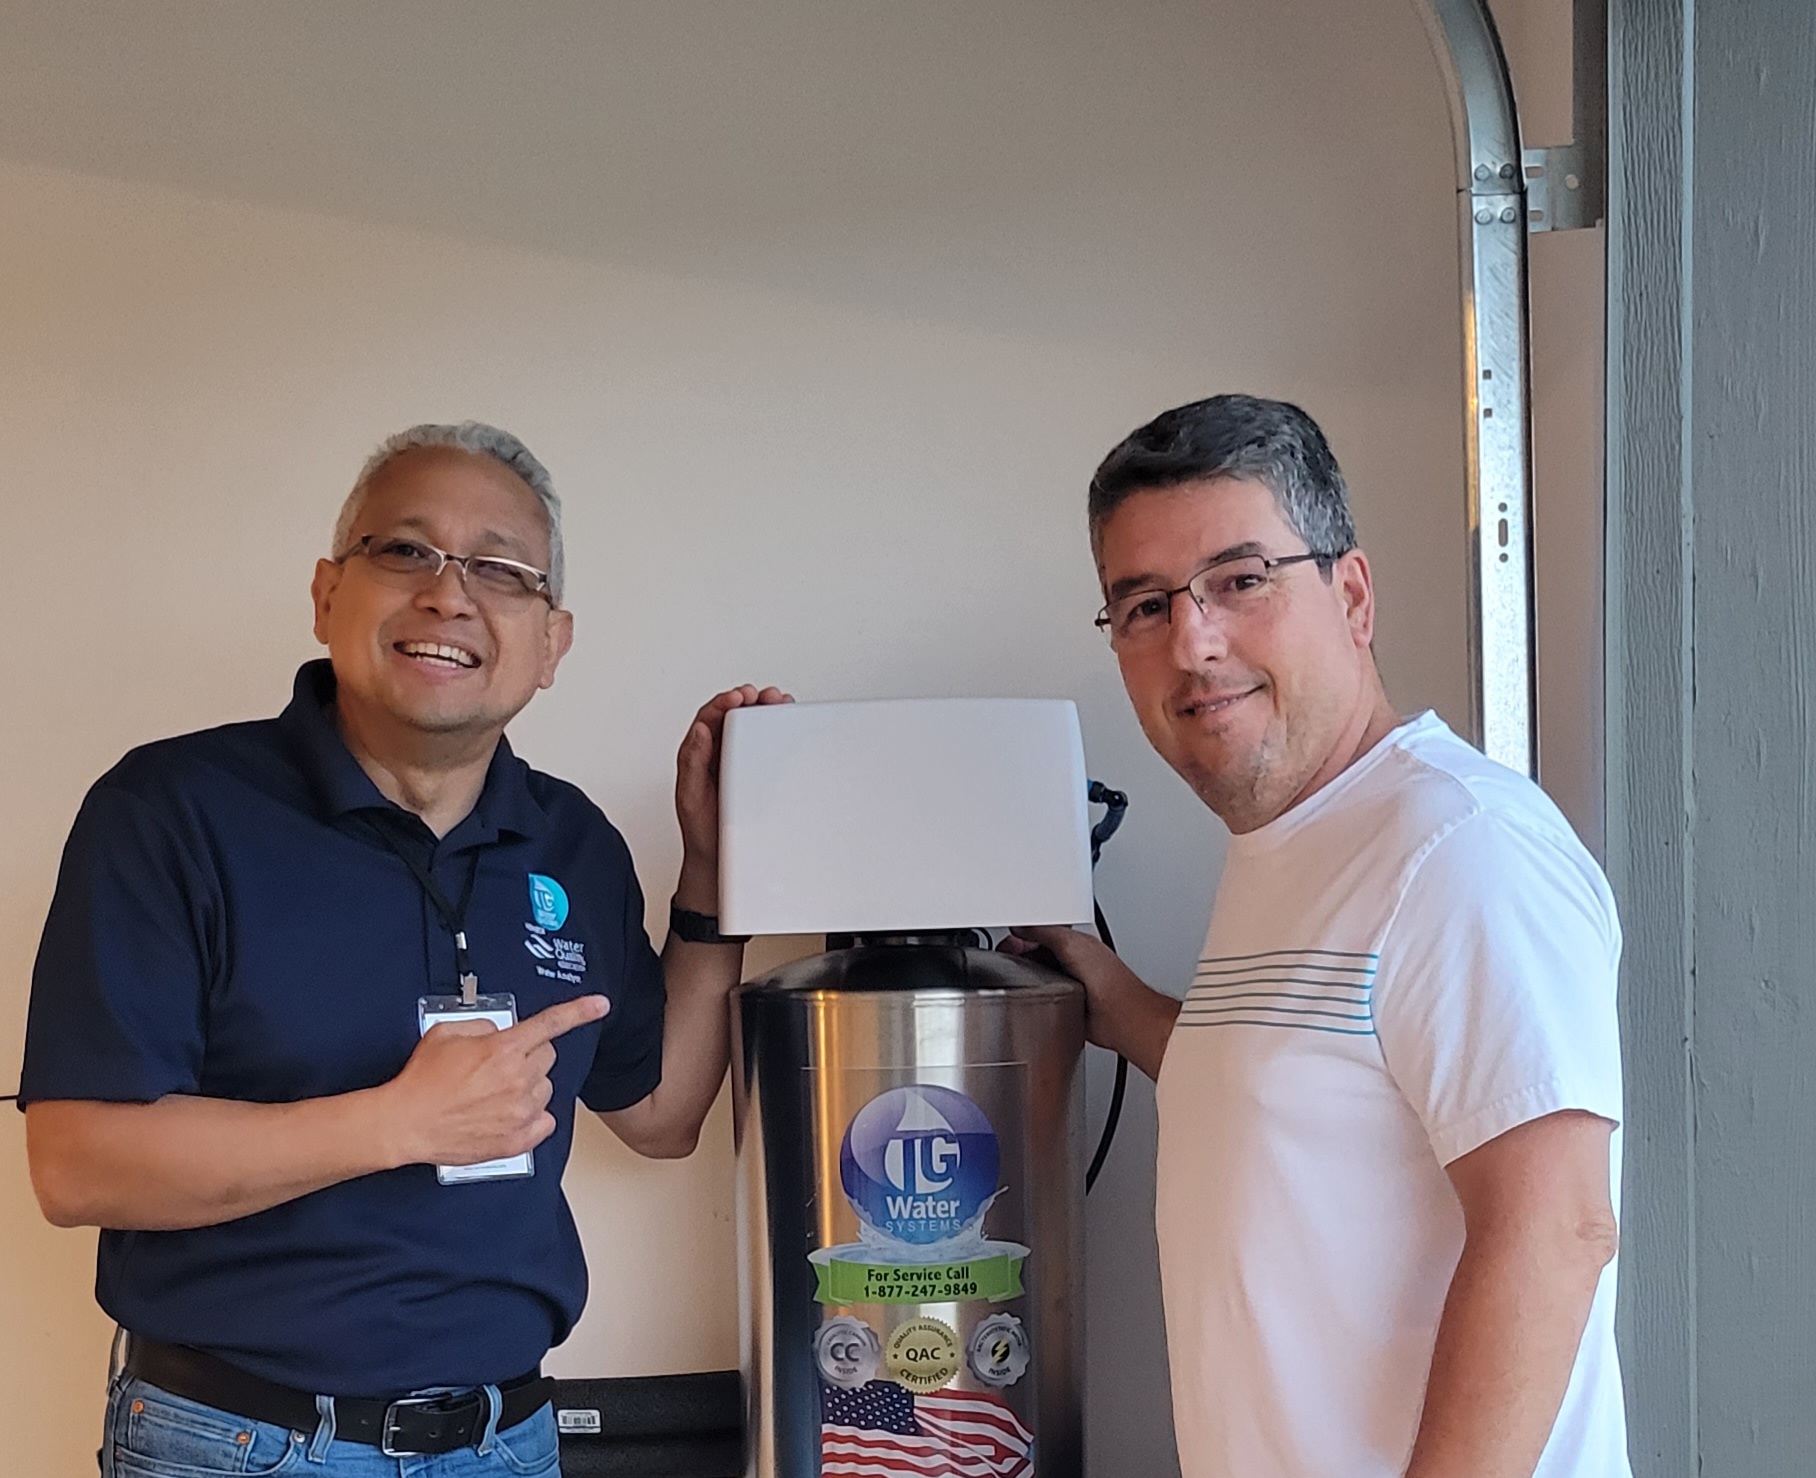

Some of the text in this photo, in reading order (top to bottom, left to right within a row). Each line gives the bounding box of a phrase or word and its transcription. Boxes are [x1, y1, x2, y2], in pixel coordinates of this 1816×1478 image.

[886, 1195, 960, 1220] Water
[885, 1219, 961, 1233] SYSTEMS
[867, 1266, 969, 1282] For Service Call
[863, 1281, 978, 1298] 1-877-247-9849
[893, 1324, 953, 1349] QUALITY ASSURANCE
[830, 1342, 860, 1362] CC
[905, 1346, 941, 1363] QAC
[899, 1367, 949, 1385] CERTIFIED
